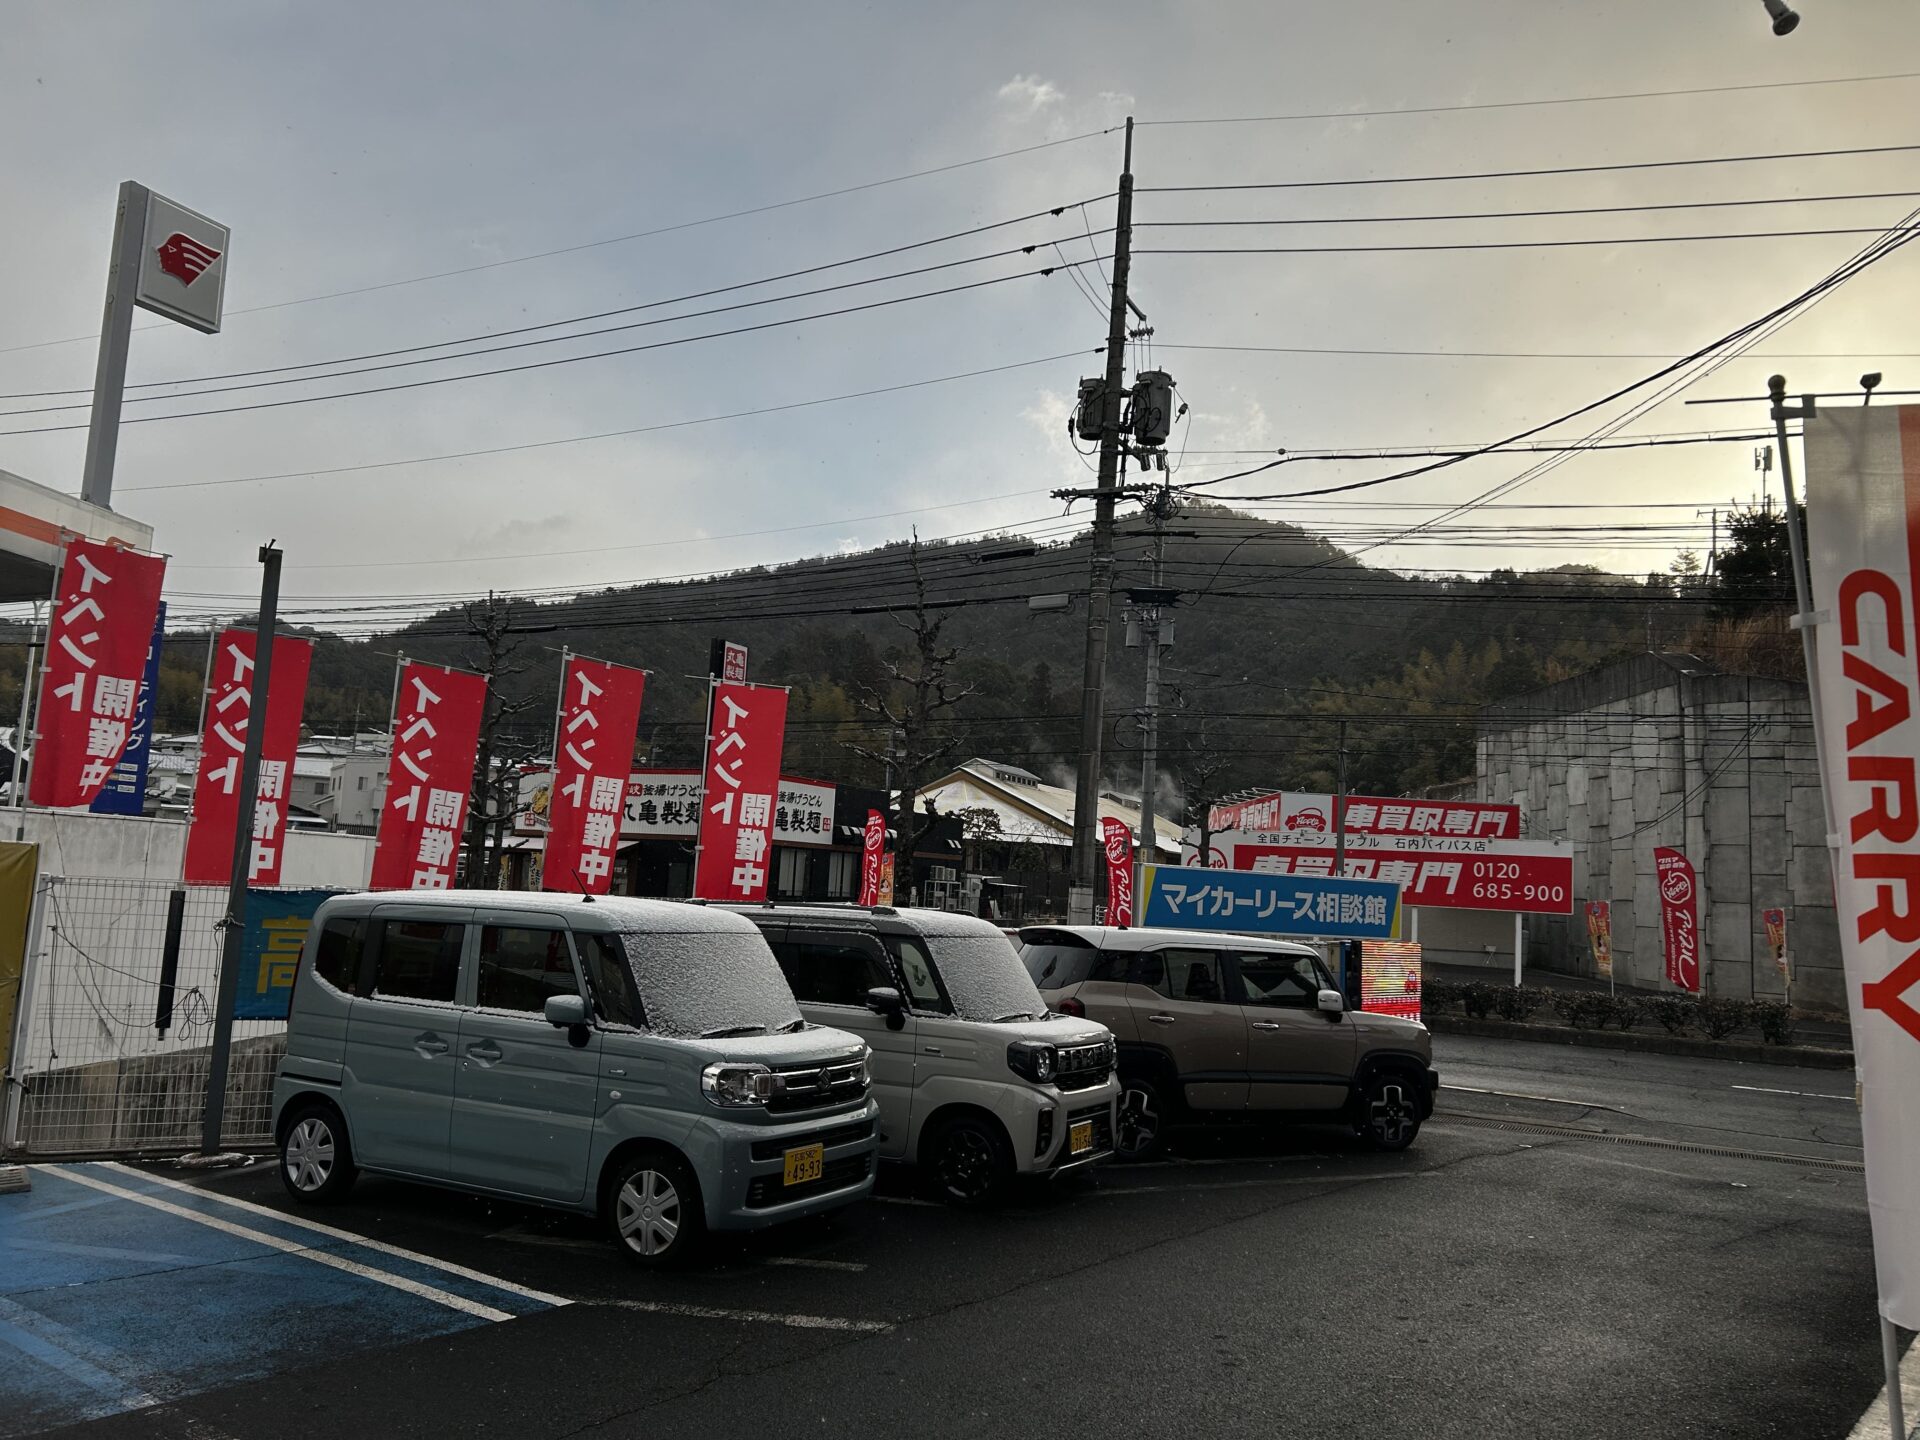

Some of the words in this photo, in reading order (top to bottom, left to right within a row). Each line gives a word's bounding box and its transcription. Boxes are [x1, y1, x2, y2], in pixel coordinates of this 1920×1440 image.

[1839, 569, 1920, 1043] CARRY
[1344, 804, 1509, 837] 車買取専門
[1257, 833, 1327, 849] 全国チェーン
[1334, 836, 1380, 848] ップル
[1395, 838, 1487, 852] 石内バイパス店
[1473, 862, 1520, 879] 0120
[1473, 882, 1564, 902] 685-900
[1161, 883, 1387, 926] マイカーリース相談館
[793, 1159, 821, 1182] 49-93
